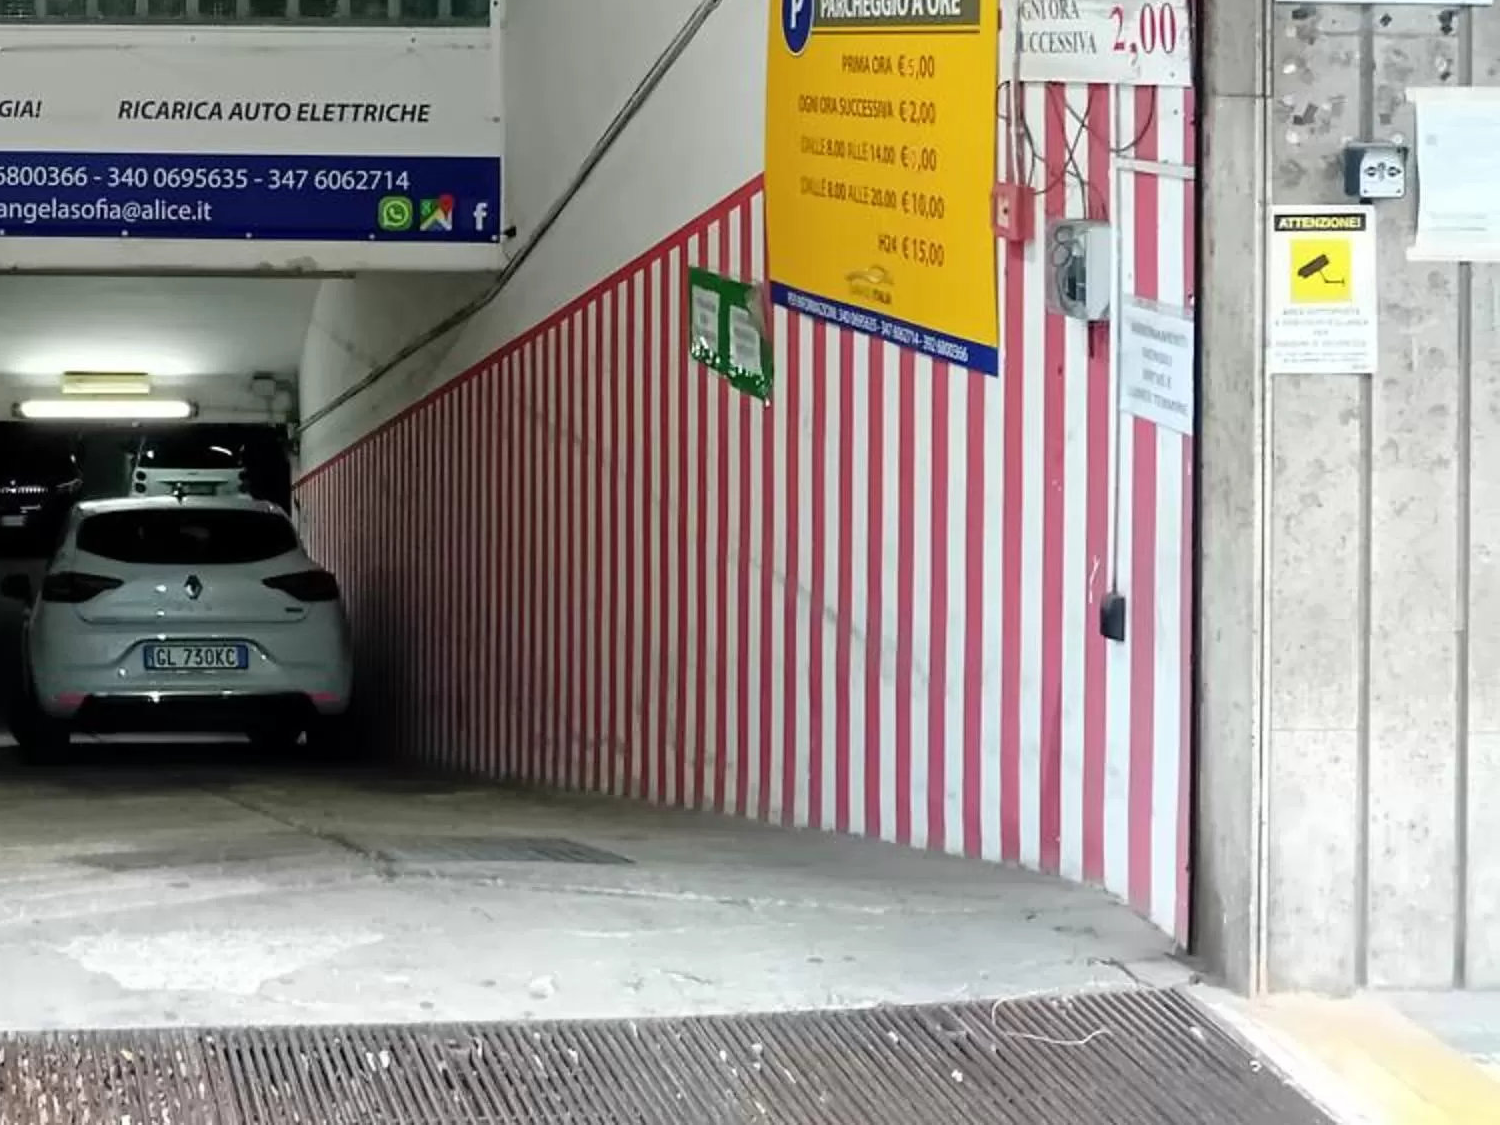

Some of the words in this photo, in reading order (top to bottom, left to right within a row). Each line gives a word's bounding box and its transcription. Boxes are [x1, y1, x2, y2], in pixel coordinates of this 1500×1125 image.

[1018, 30, 1097, 55] UCCESSIVA
[1108, 2, 1177, 65] 2,00
[841, 53, 871, 74] PRIMA
[872, 55, 893, 75] ORA
[118, 100, 223, 121] RICARICA
[228, 101, 291, 122] AUTO
[297, 102, 431, 123] ELETTRICHE
[108, 167, 148, 188] 340
[153, 169, 248, 189] 0695635
[268, 169, 309, 190] 347
[313, 170, 410, 191] 6062714
[911, 237, 946, 268] 15,00
